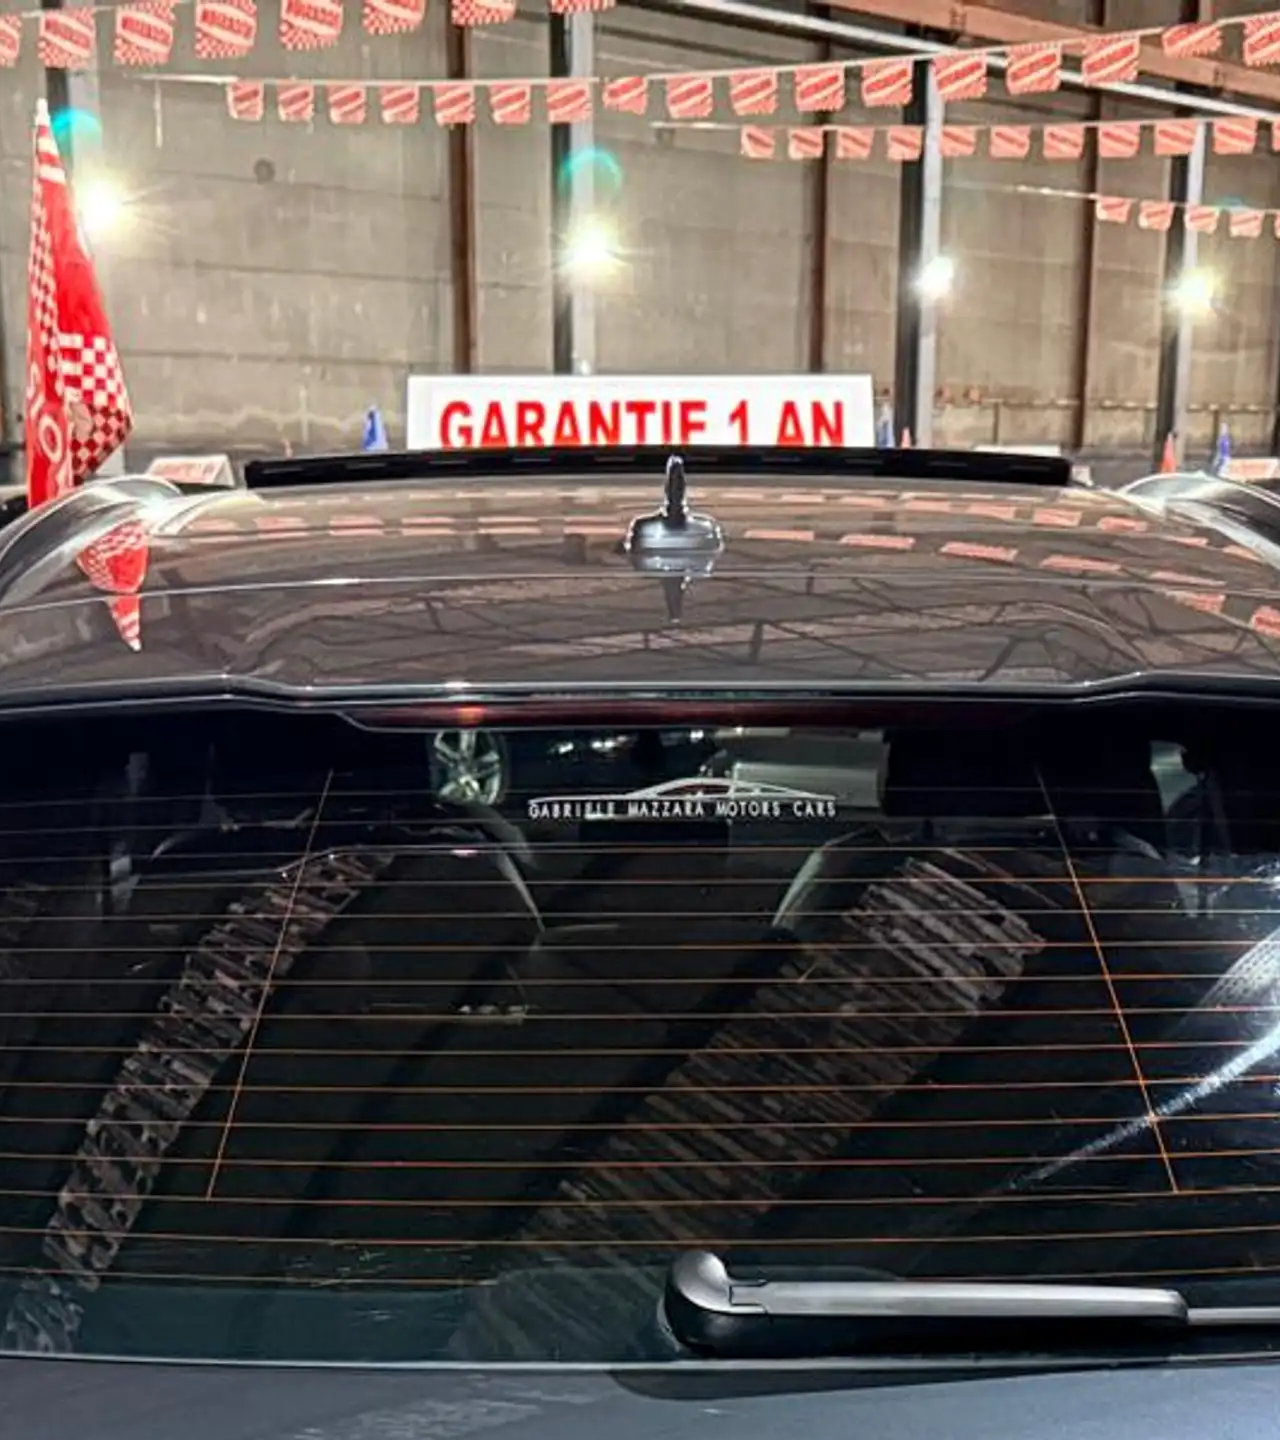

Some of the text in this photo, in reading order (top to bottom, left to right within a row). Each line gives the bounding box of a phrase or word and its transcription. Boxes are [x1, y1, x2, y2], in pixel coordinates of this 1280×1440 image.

[439, 400, 844, 447] GARANTIE 1 AN
[627, 800, 704, 817] MAZZARA
[716, 800, 781, 817] MOTORS
[792, 800, 836, 817] CARS
